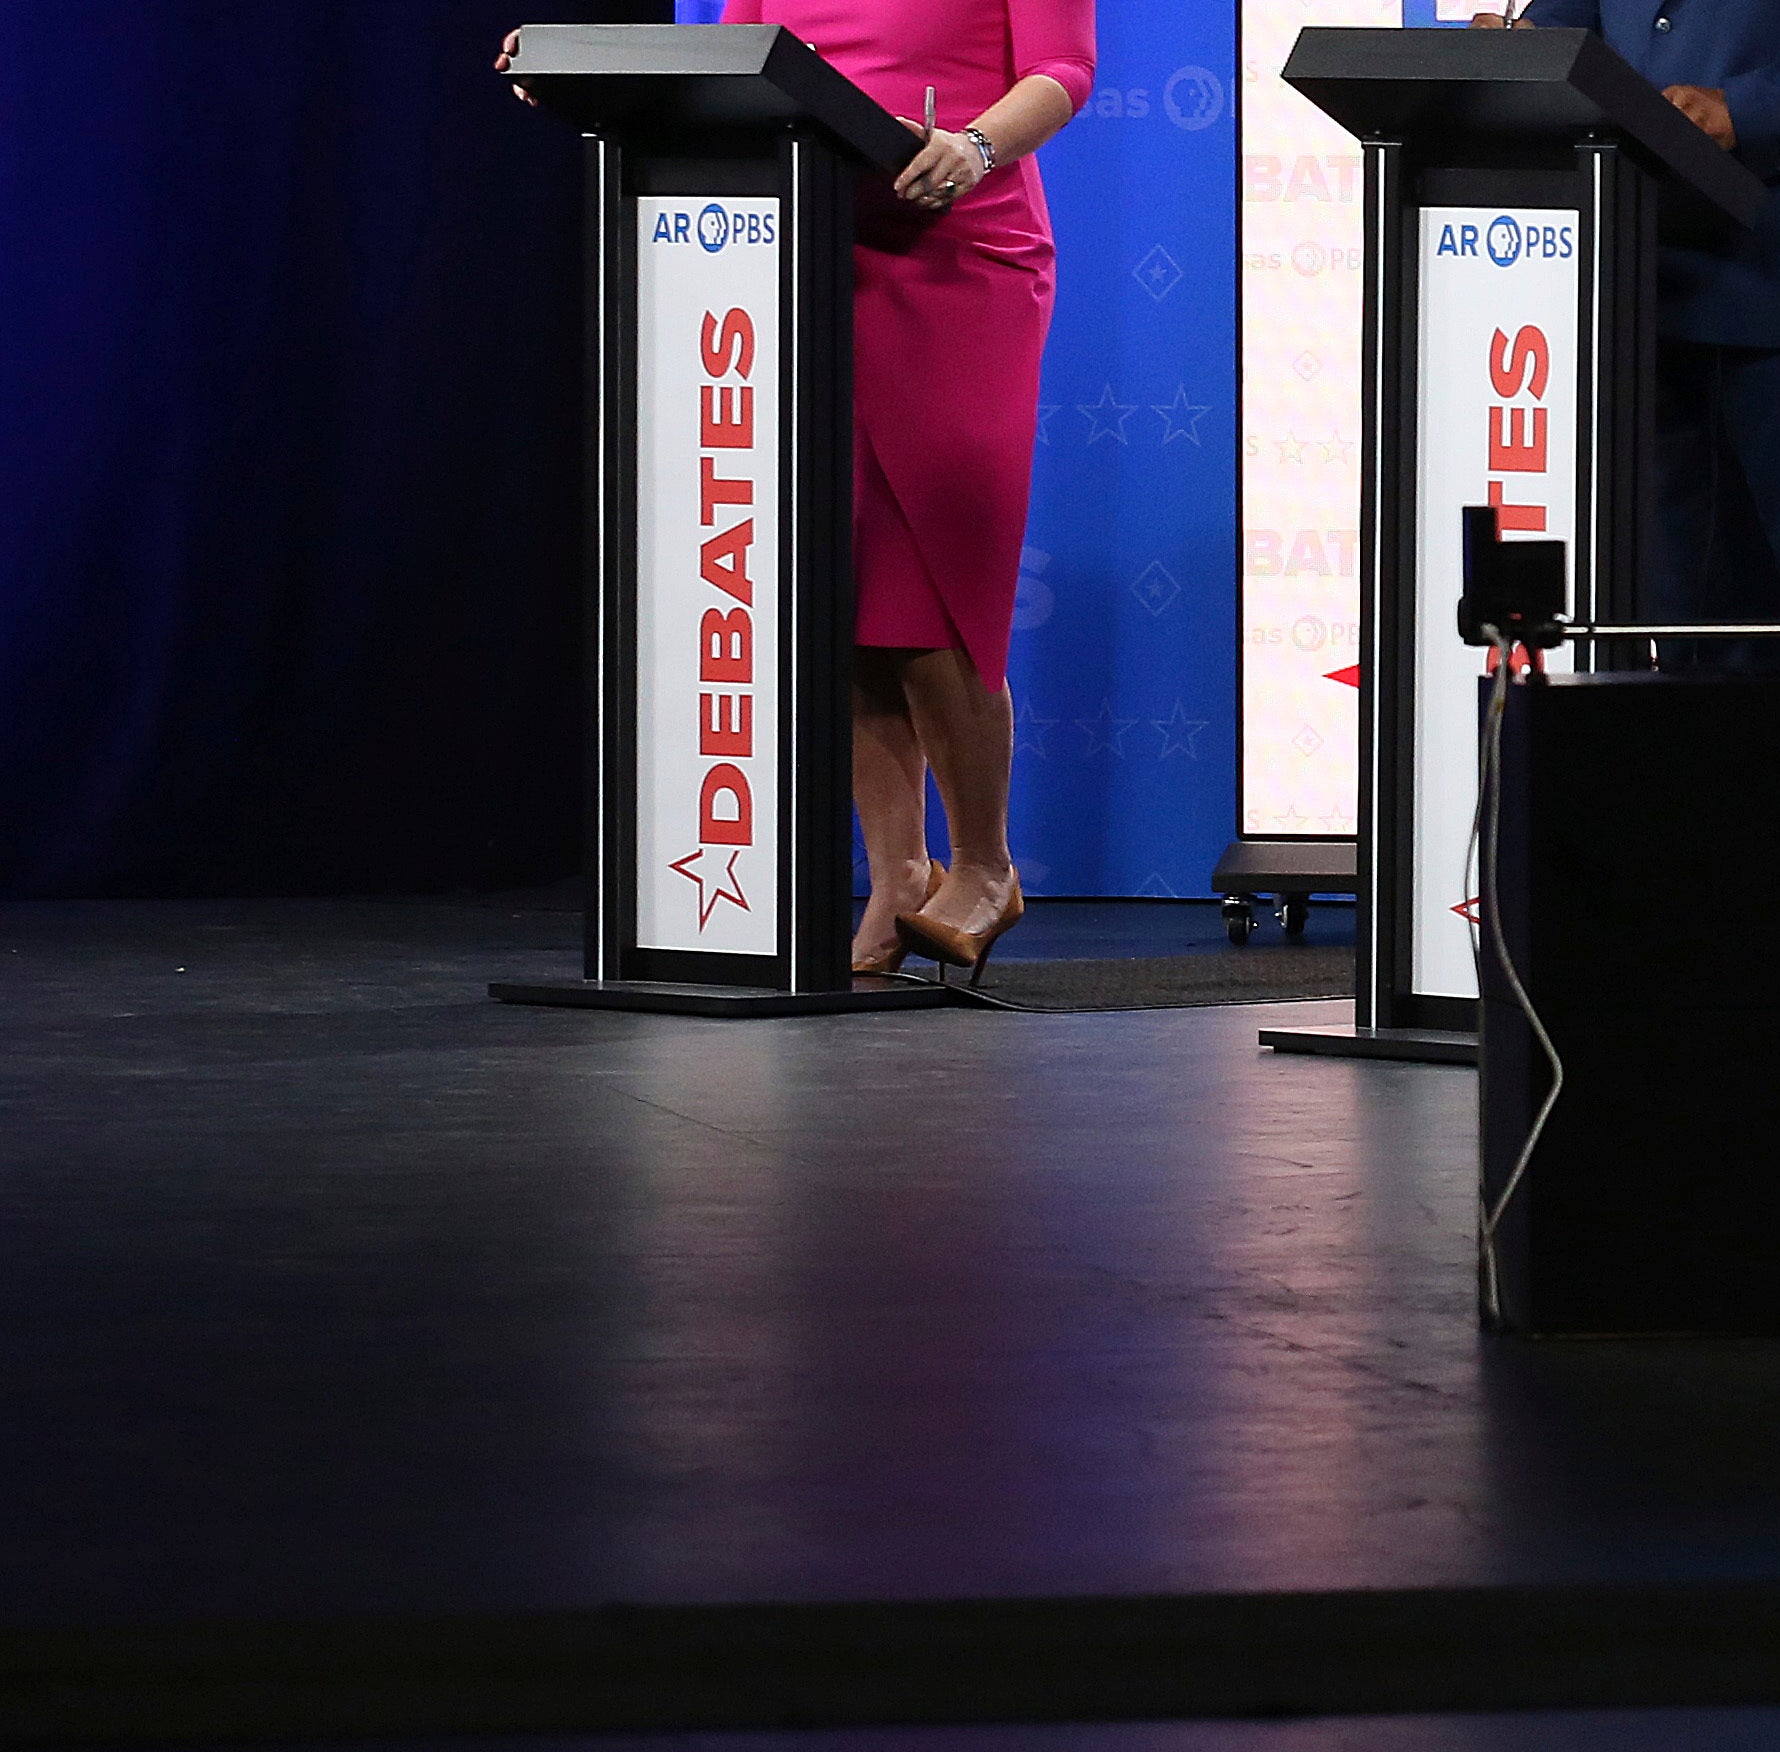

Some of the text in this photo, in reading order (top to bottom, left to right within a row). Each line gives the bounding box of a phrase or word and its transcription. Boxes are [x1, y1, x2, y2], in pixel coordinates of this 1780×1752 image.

[651, 212, 775, 246] AR PBS
[1436, 225, 1574, 260] AR PBS
[699, 306, 757, 846] DEBATES
